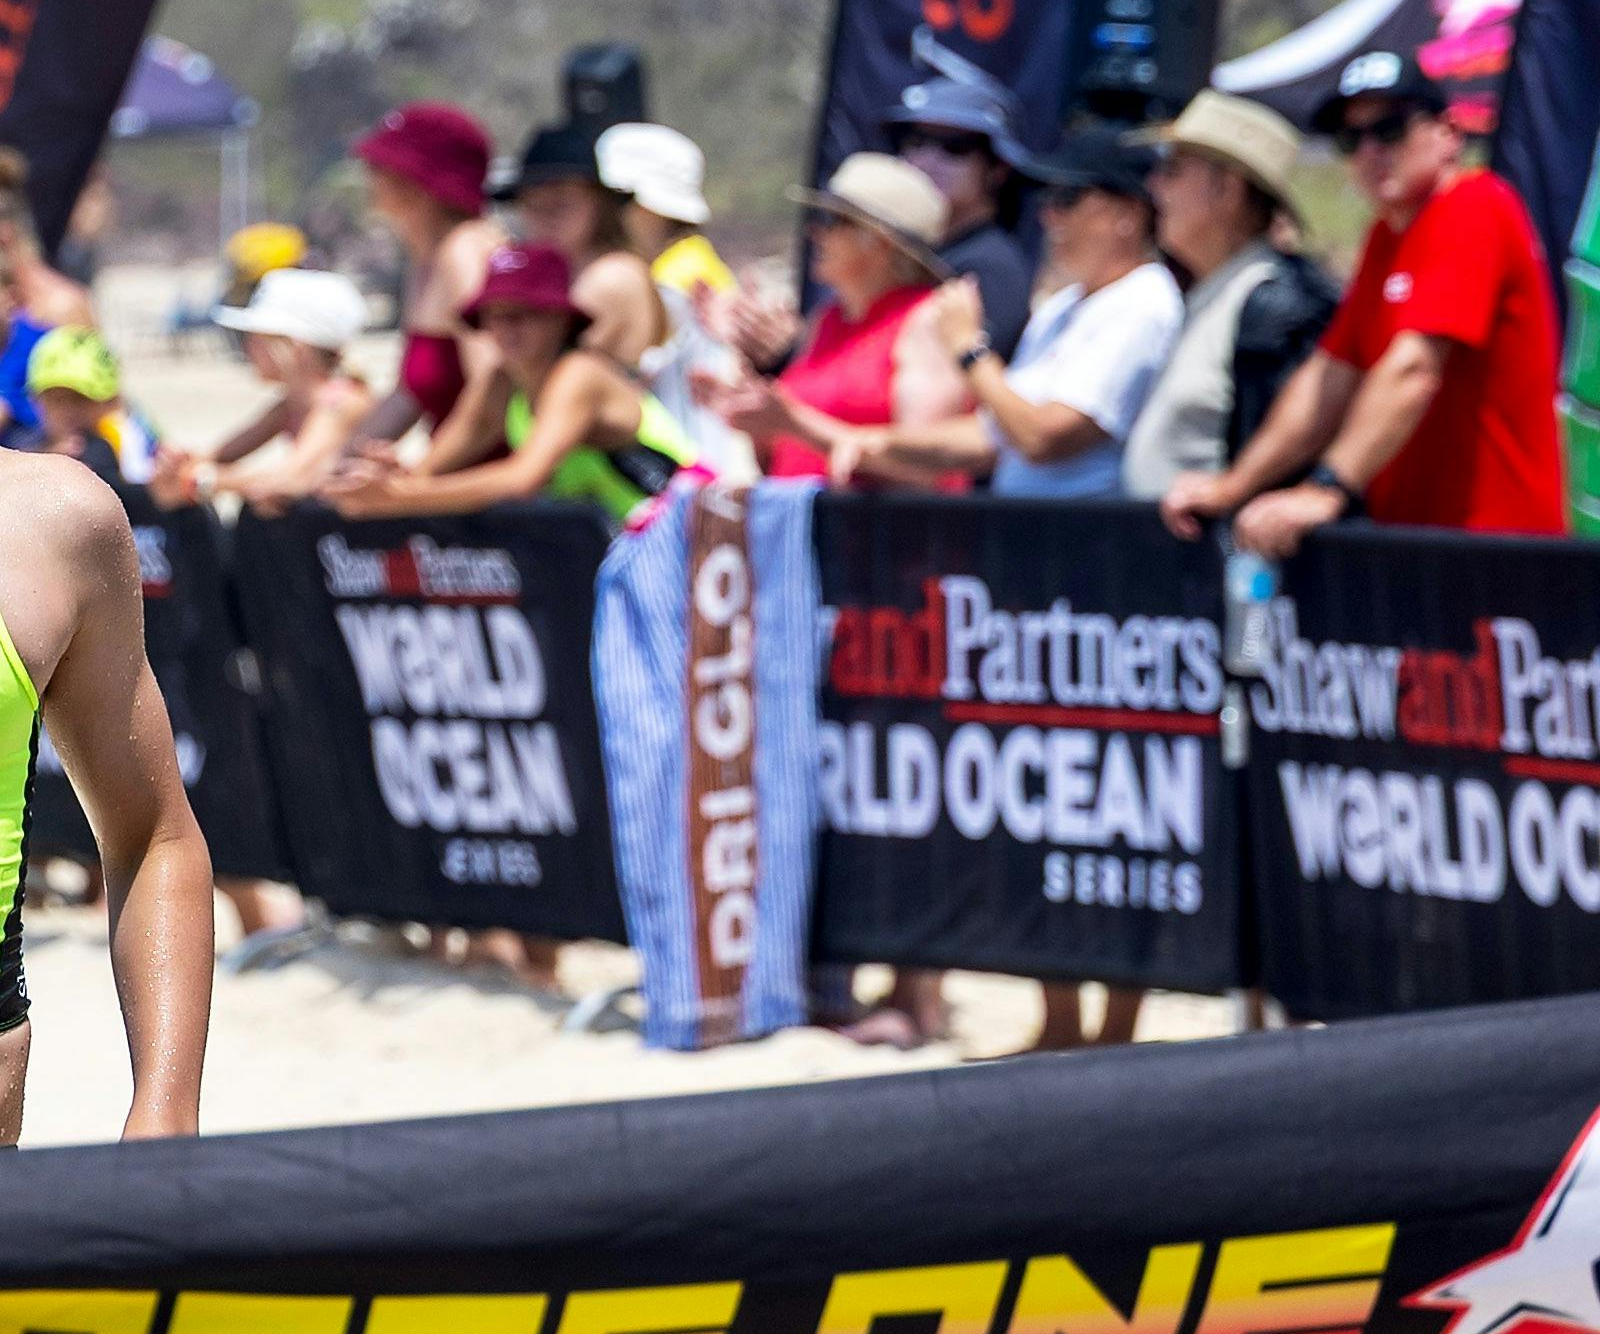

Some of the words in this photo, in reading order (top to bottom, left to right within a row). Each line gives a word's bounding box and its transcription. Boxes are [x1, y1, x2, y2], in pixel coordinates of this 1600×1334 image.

[334, 603, 547, 717] WORLD
[370, 716, 578, 837] OCEAN
[943, 721, 1205, 855] OCEAN
[1276, 760, 1506, 904] WORLD
[1042, 851, 1203, 916] SERIES
